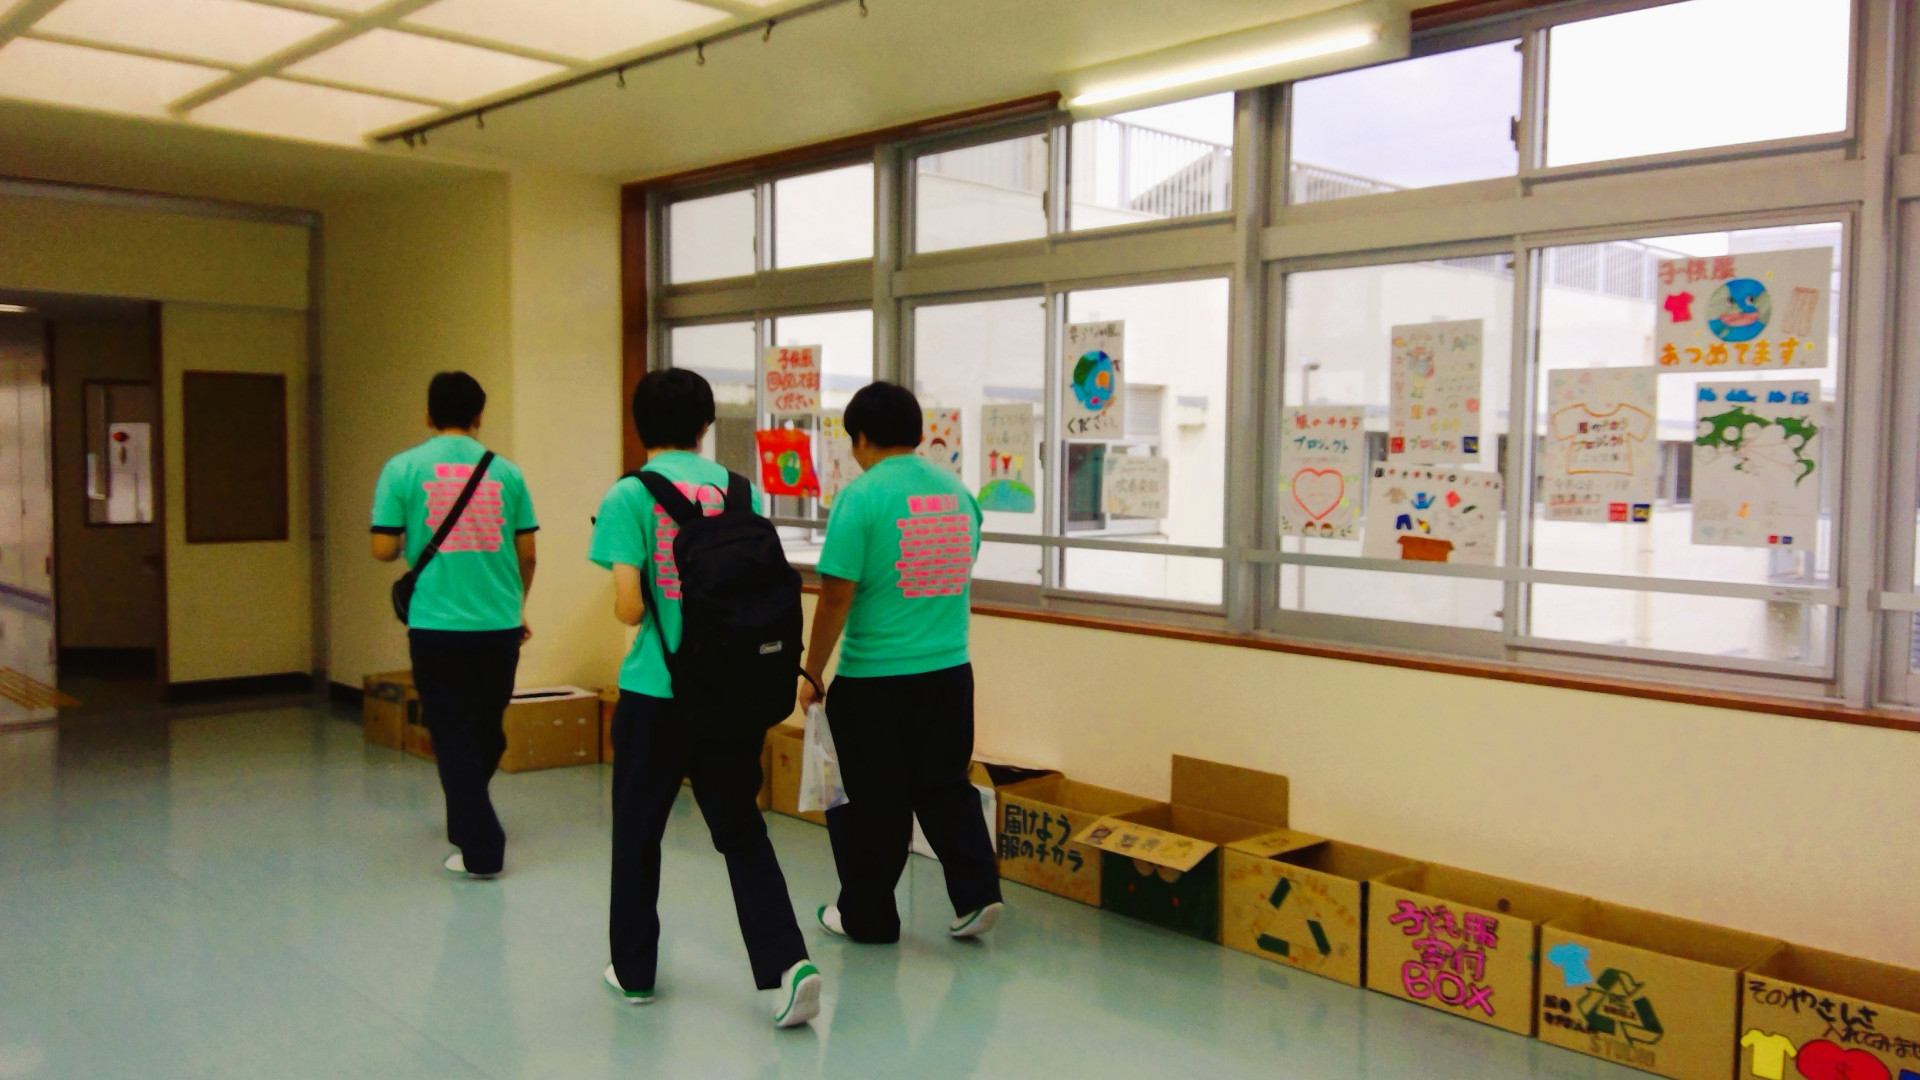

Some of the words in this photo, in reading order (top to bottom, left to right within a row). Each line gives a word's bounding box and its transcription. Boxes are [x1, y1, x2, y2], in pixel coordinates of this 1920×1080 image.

[1657, 256, 1736, 285] 子供服
[1004, 803, 1071, 847] 届けよう
[999, 833, 1085, 873] 服のチカラ
[1412, 934, 1486, 982] 寄付
[1401, 959, 1495, 1017] BOX
[1747, 980, 1879, 1030] そのやさしさ
